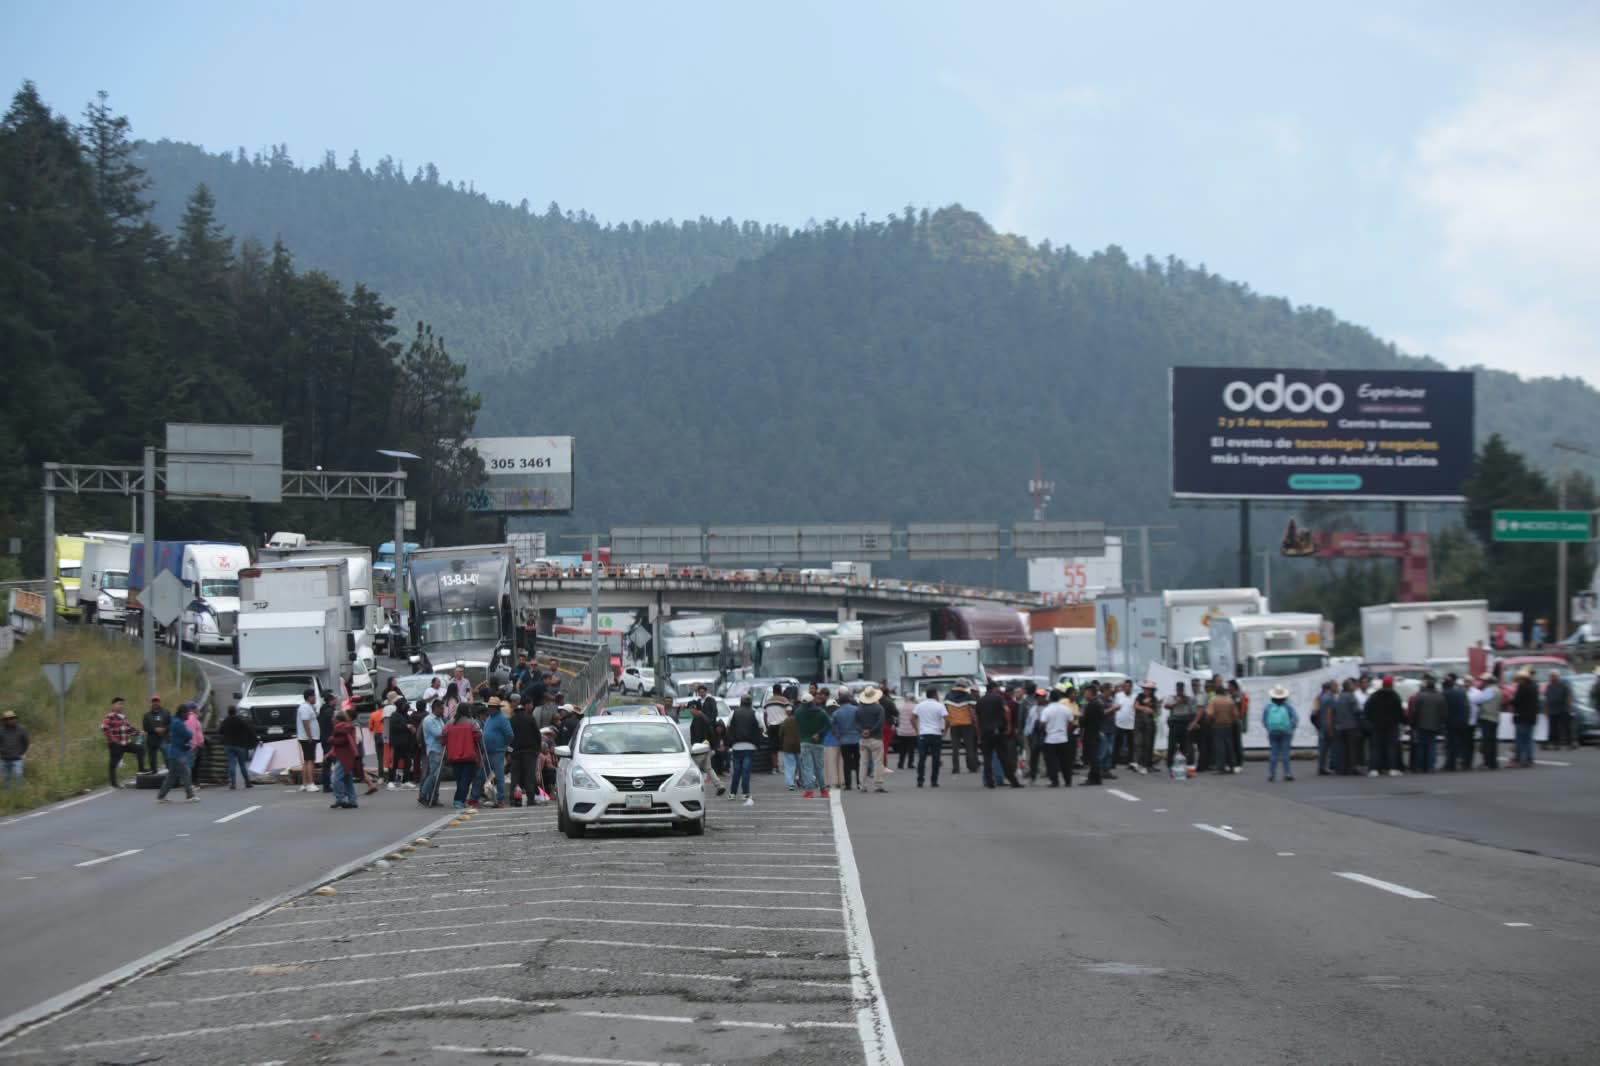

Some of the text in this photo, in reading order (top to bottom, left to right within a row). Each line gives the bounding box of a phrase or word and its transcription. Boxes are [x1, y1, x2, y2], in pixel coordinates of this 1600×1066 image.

[1223, 374, 1344, 413] odoo
[1247, 418, 1262, 428] de
[1264, 418, 1329, 430] septiembre
[1338, 419, 1377, 429] Centro
[1211, 436, 1225, 448] El
[1226, 438, 1273, 449] evento
[1275, 438, 1293, 449] de
[1367, 441, 1376, 452] y
[491, 457, 552, 470] 305 3461
[1211, 452, 1439, 466] más importante de América Latina
[1064, 563, 1088, 588] 55
